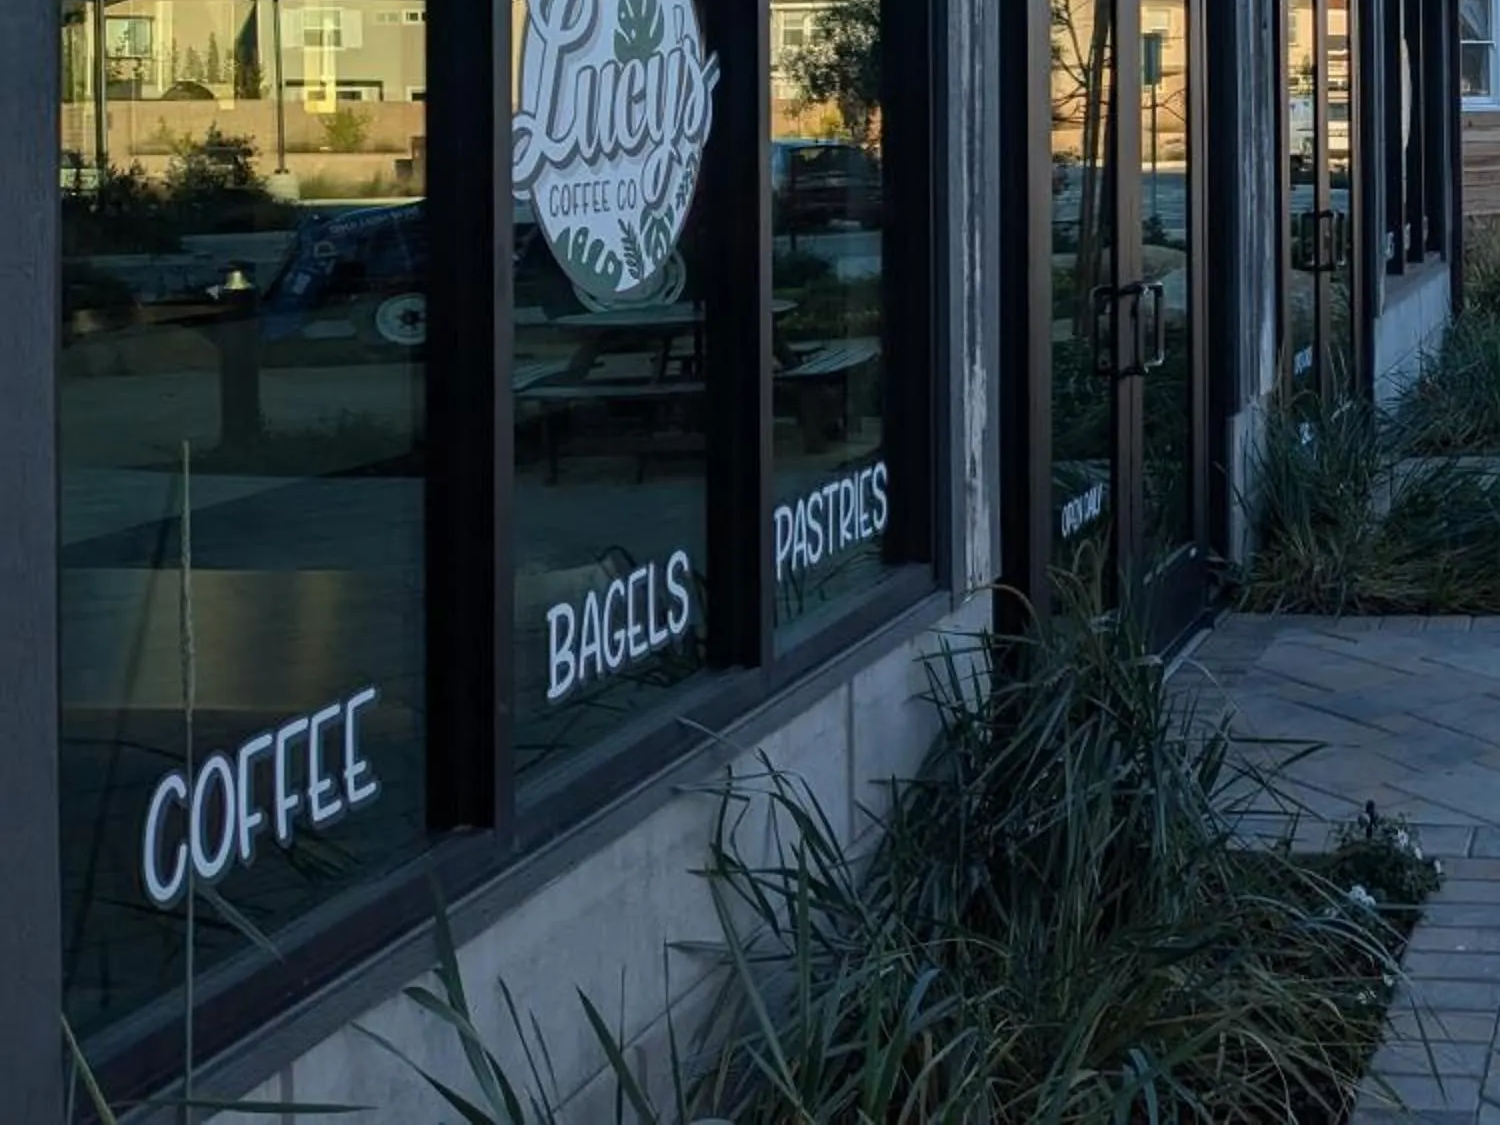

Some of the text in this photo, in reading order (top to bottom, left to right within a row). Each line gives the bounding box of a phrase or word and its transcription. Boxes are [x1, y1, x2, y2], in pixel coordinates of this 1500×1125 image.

[549, 179, 611, 217] COFFEE
[773, 461, 888, 581] PASTRIES
[547, 549, 690, 699] BAGELS
[143, 687, 377, 902] COFFEE
